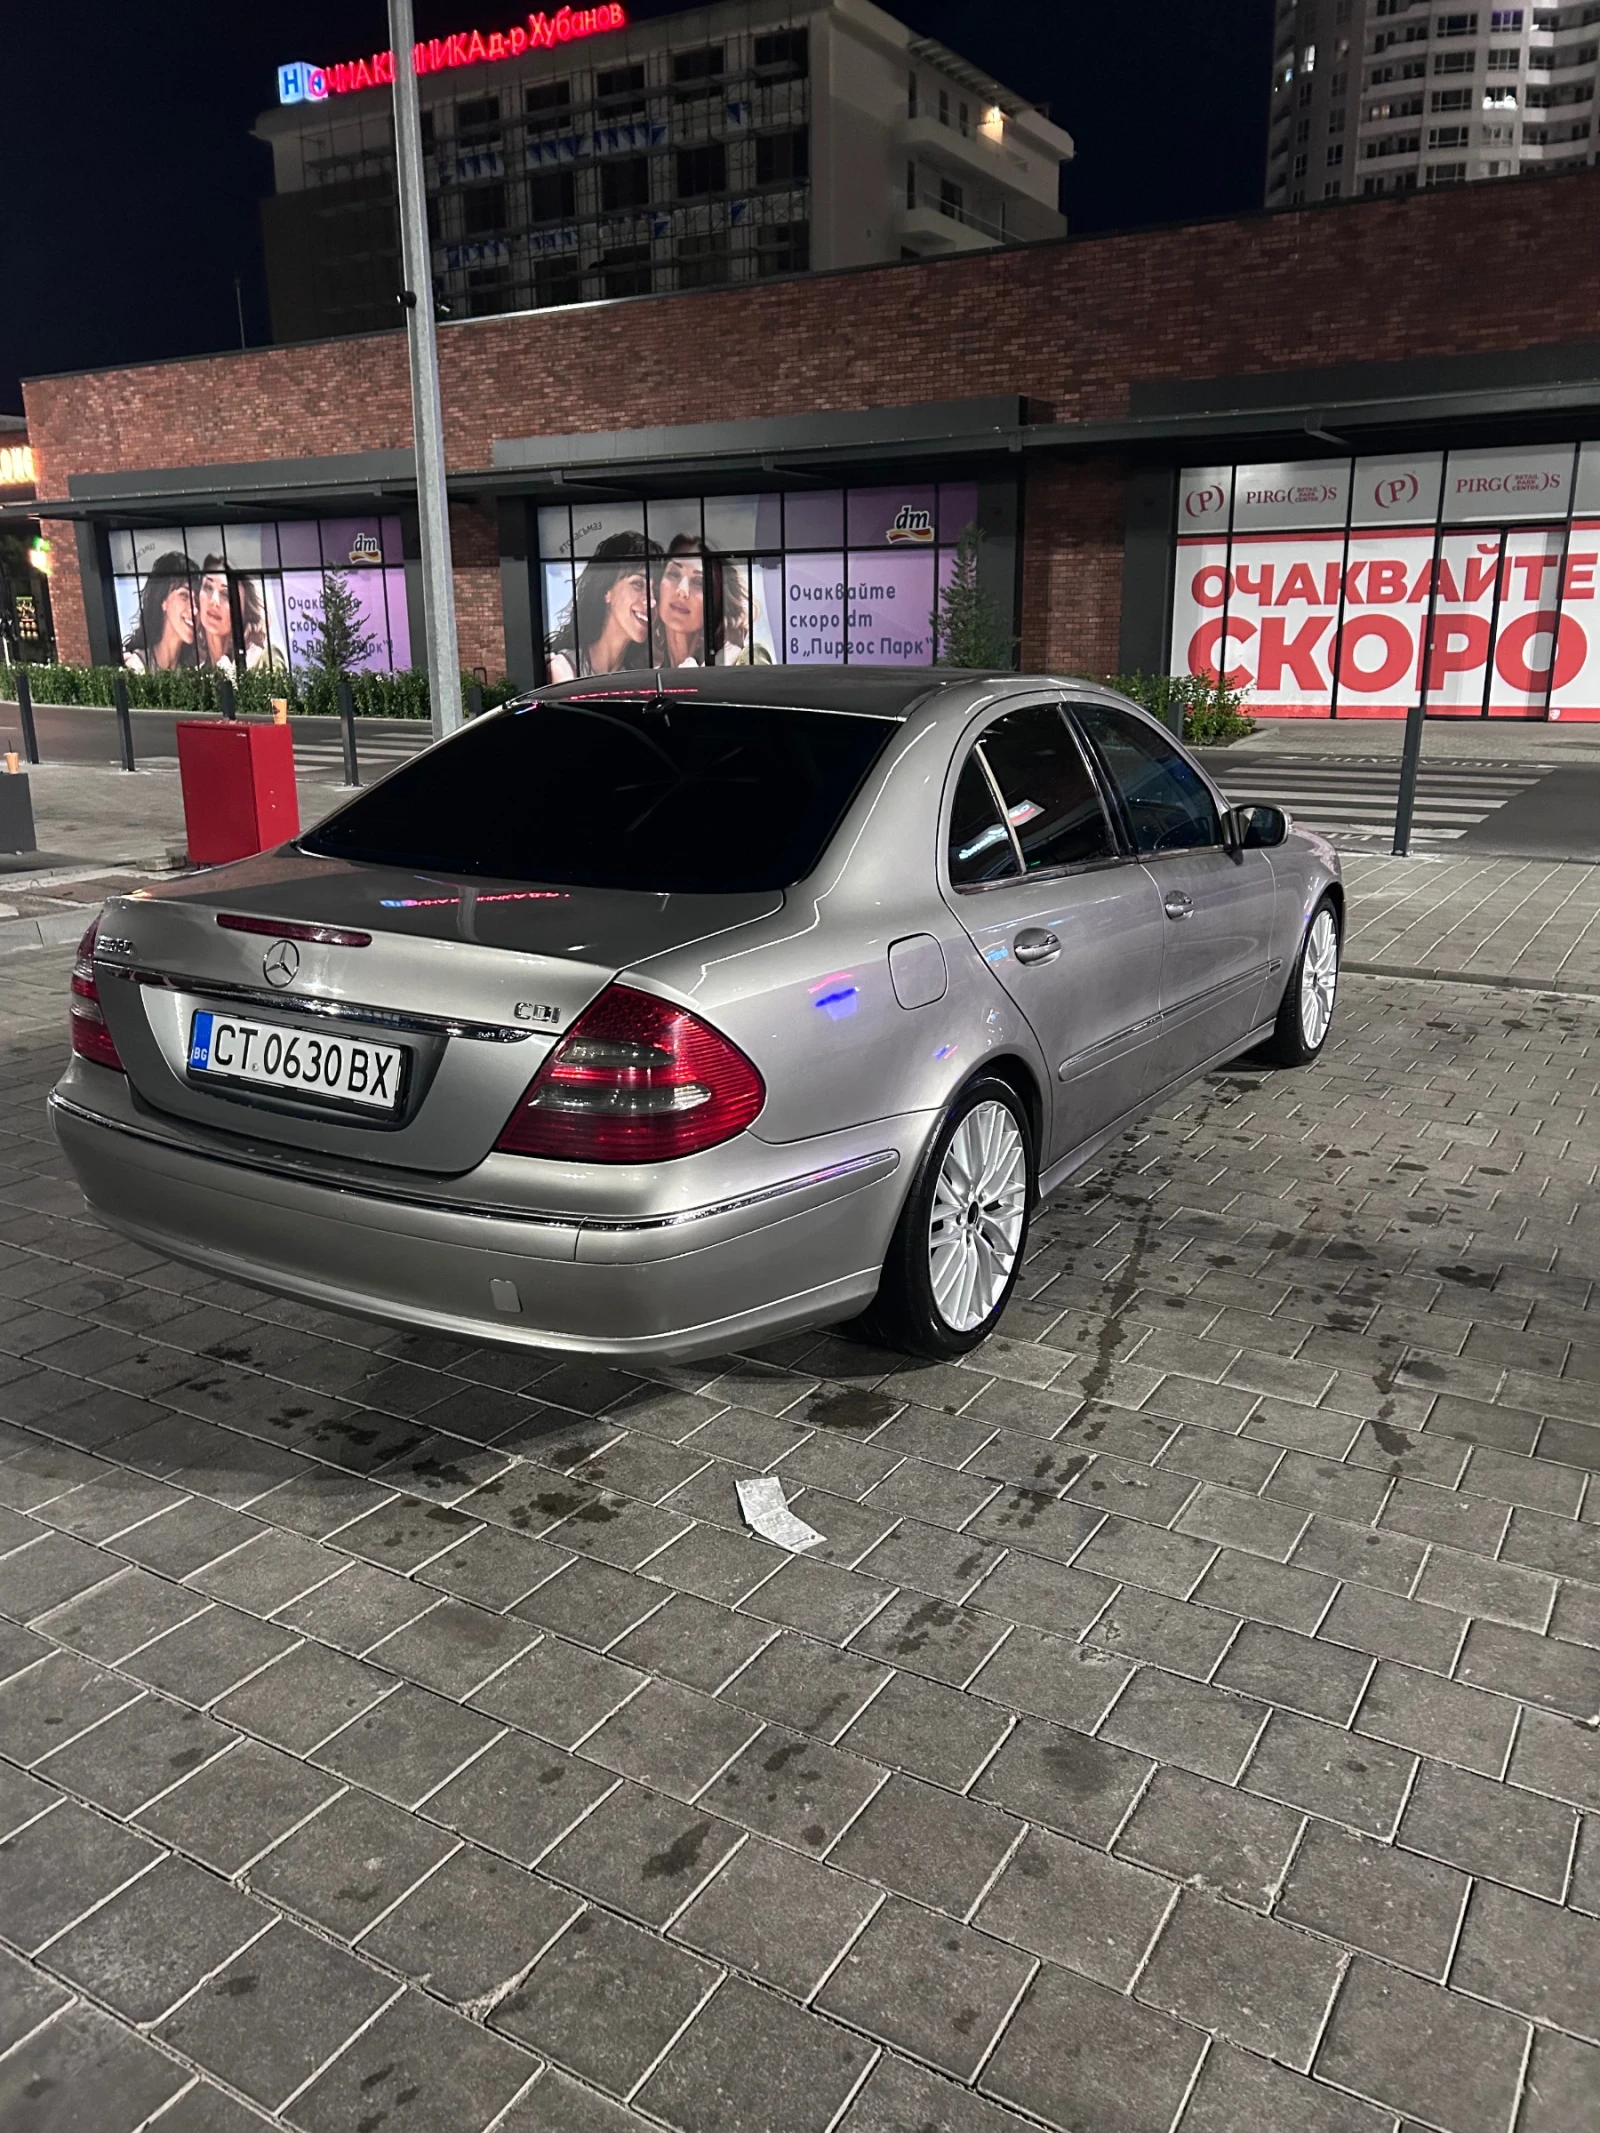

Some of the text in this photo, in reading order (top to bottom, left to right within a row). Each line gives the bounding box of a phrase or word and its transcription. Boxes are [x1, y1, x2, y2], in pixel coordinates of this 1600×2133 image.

[373, 29, 488, 82] КНИКА
[529, 3, 624, 47] Хубанов
[895, 506, 929, 530] dm
[354, 533, 377, 551] dm
[1191, 543, 1598, 608] ОЧАКВАЙТЕ
[790, 583, 896, 601] Очаквайте
[790, 609, 873, 632] скоро dm
[1188, 610, 1588, 694] СКОРО
[513, 1001, 561, 1024] CDI
[193, 1046, 208, 1061] BG
[214, 1024, 394, 1099] CT 0630 BX
